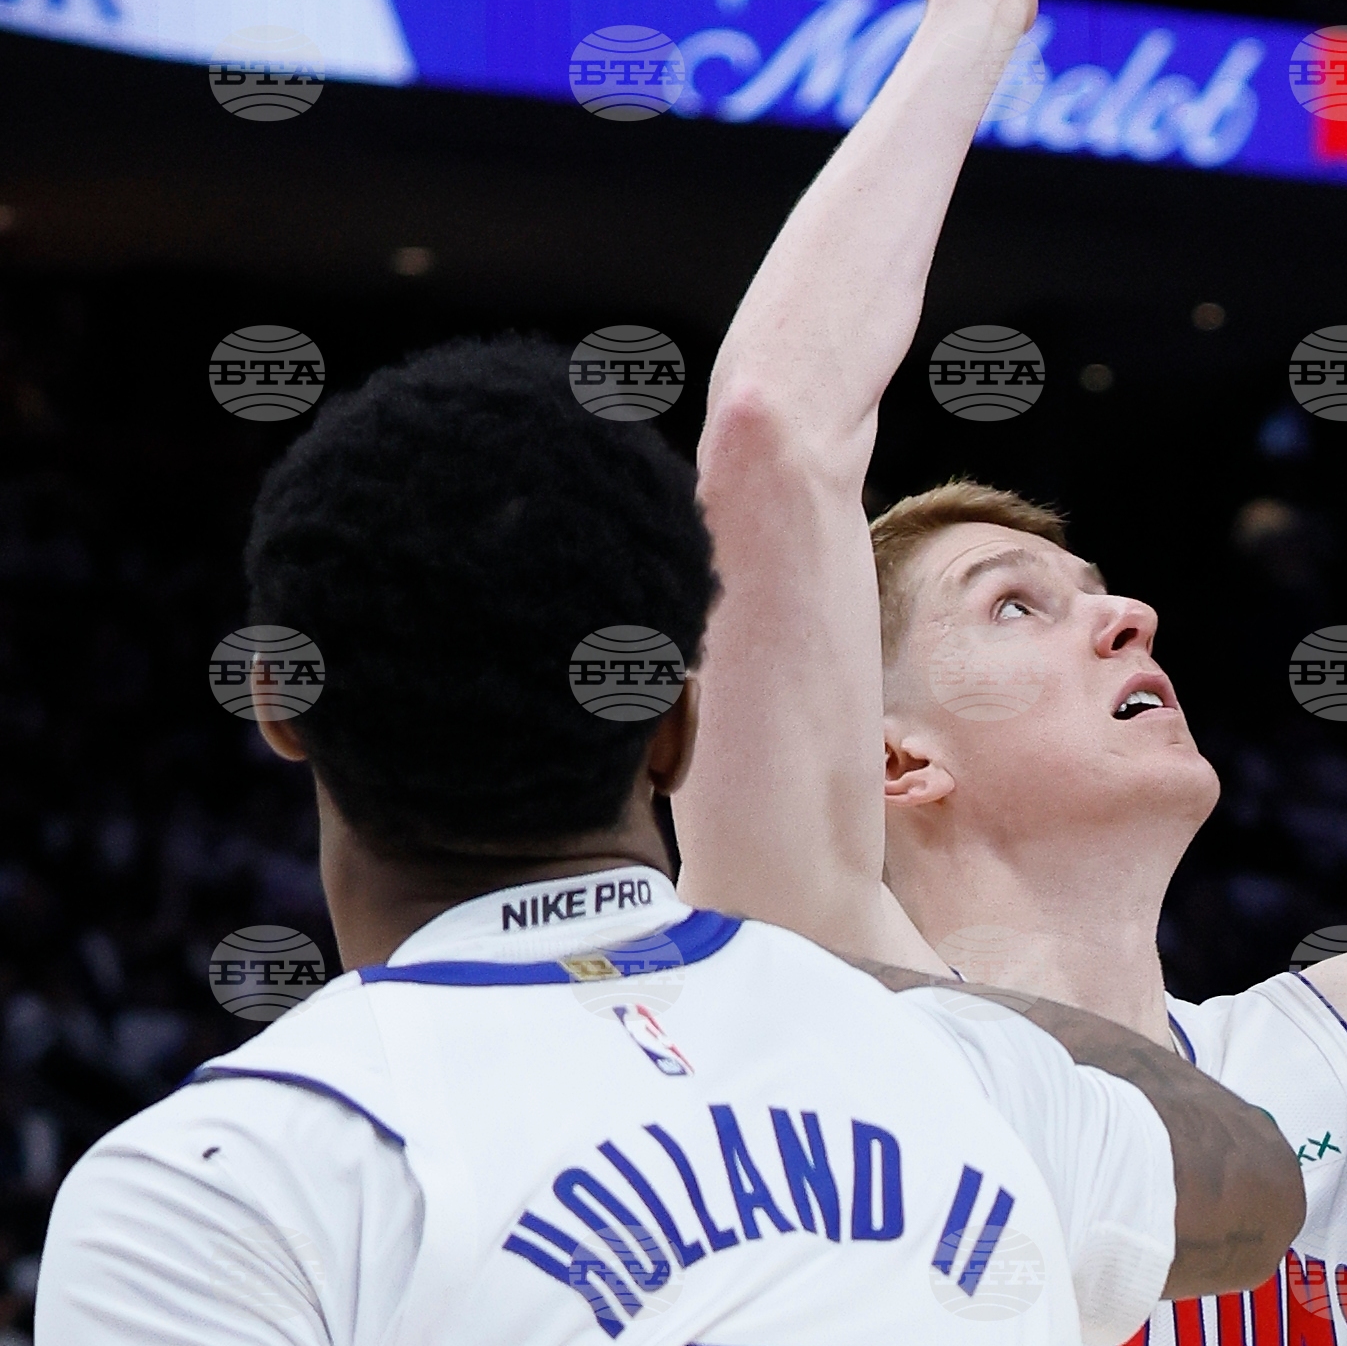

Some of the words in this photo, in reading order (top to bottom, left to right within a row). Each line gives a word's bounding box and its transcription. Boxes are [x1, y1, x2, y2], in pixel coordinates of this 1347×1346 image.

[502, 887, 586, 932] NIKE
[594, 879, 652, 913] PRO
[502, 1103, 905, 1340] HOLLAND
